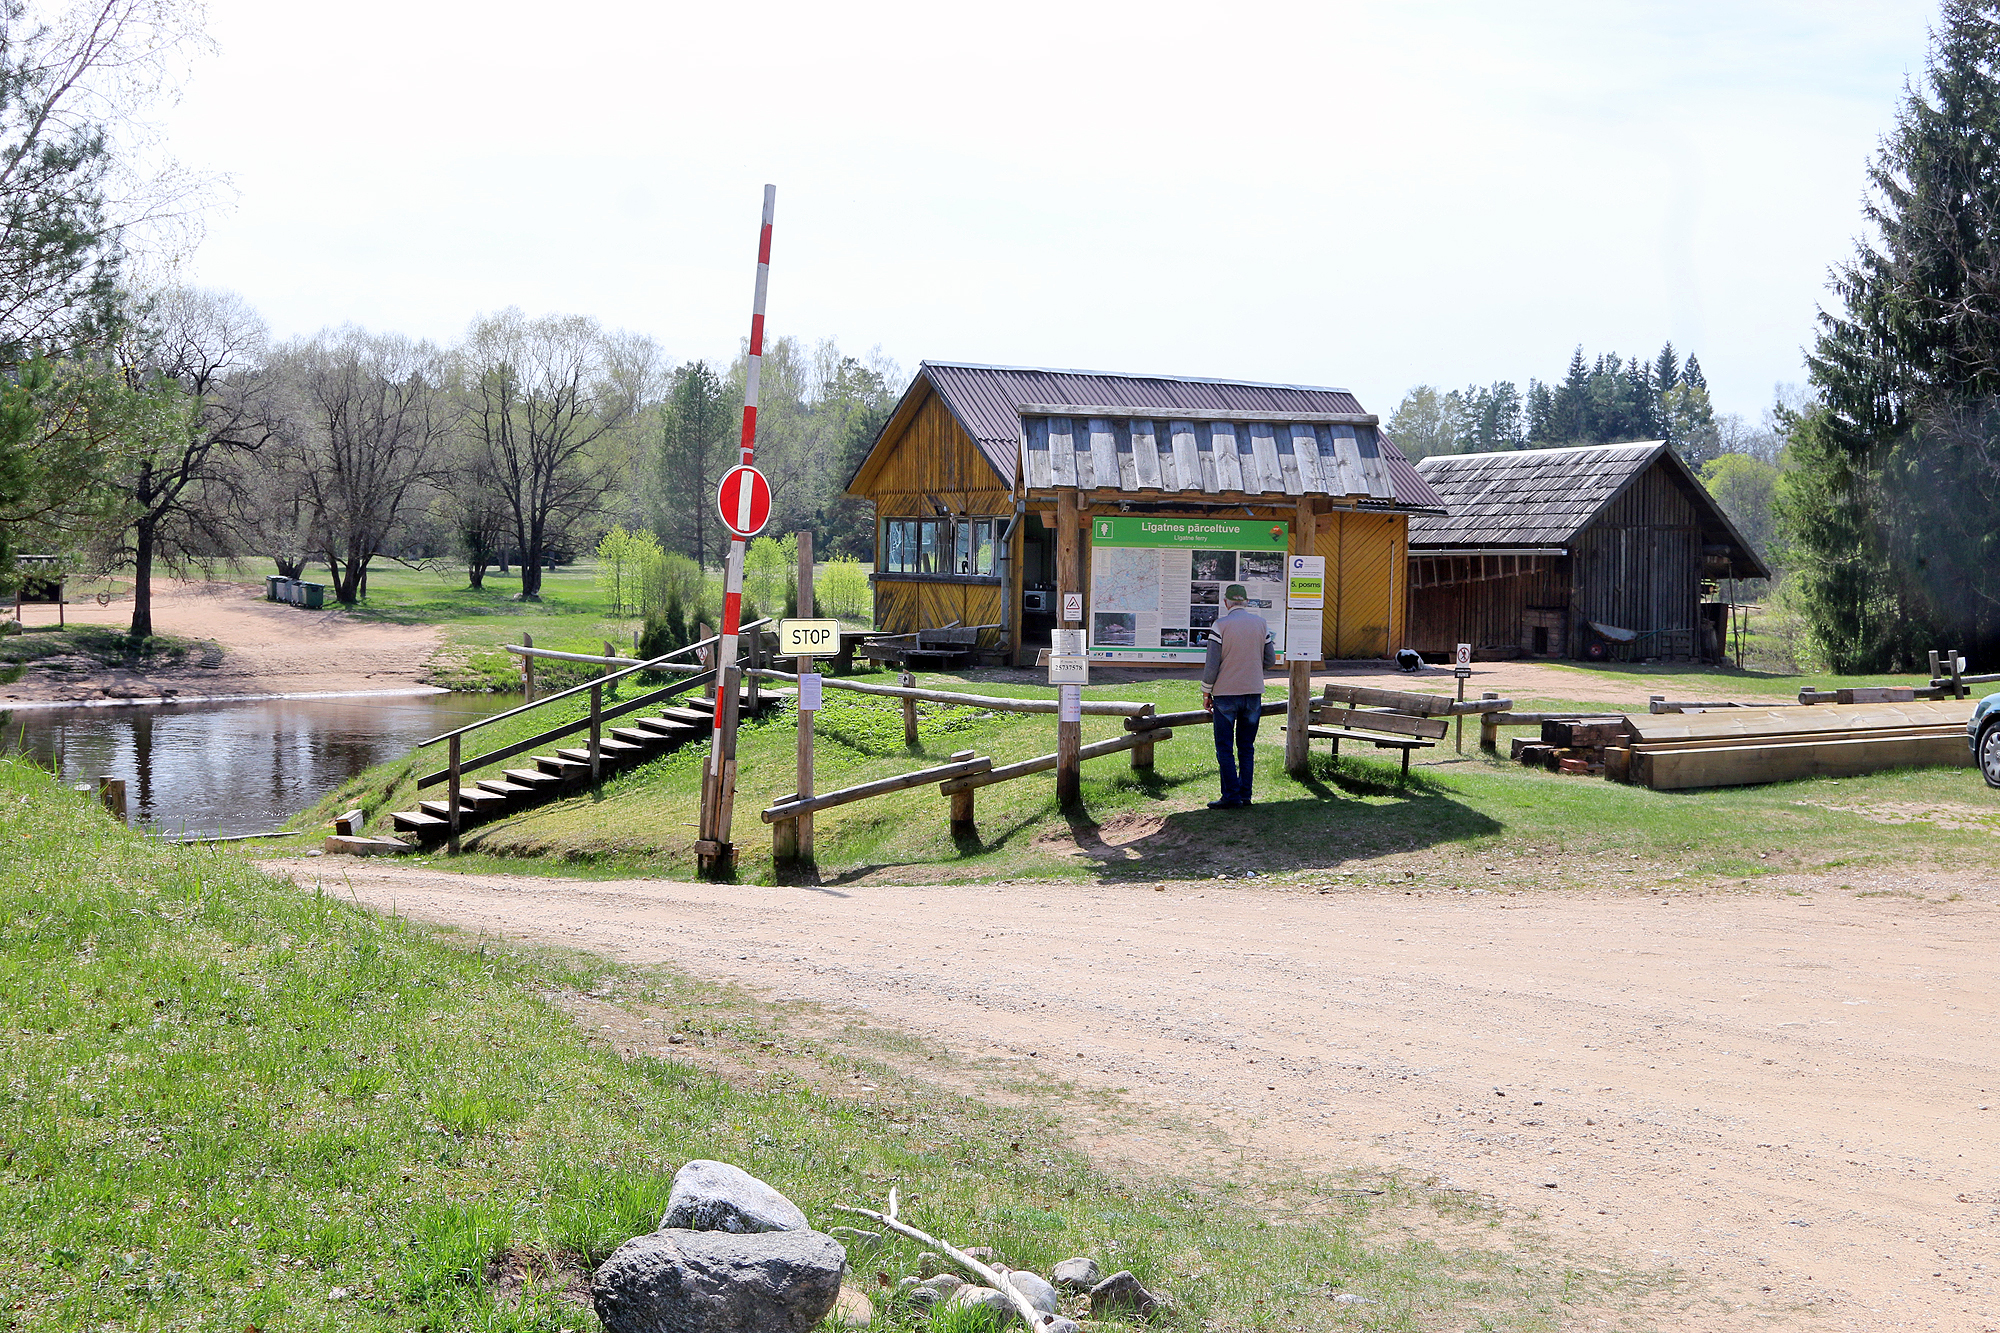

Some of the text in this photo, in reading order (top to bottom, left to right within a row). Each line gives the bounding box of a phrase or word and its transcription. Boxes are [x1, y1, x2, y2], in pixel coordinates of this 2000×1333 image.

[1141, 522, 1241, 534] Līgatnes pārceltuve
[1173, 534, 1208, 543] Līgatne ferry
[1293, 558, 1304, 569] G
[792, 629, 831, 645] STOP
